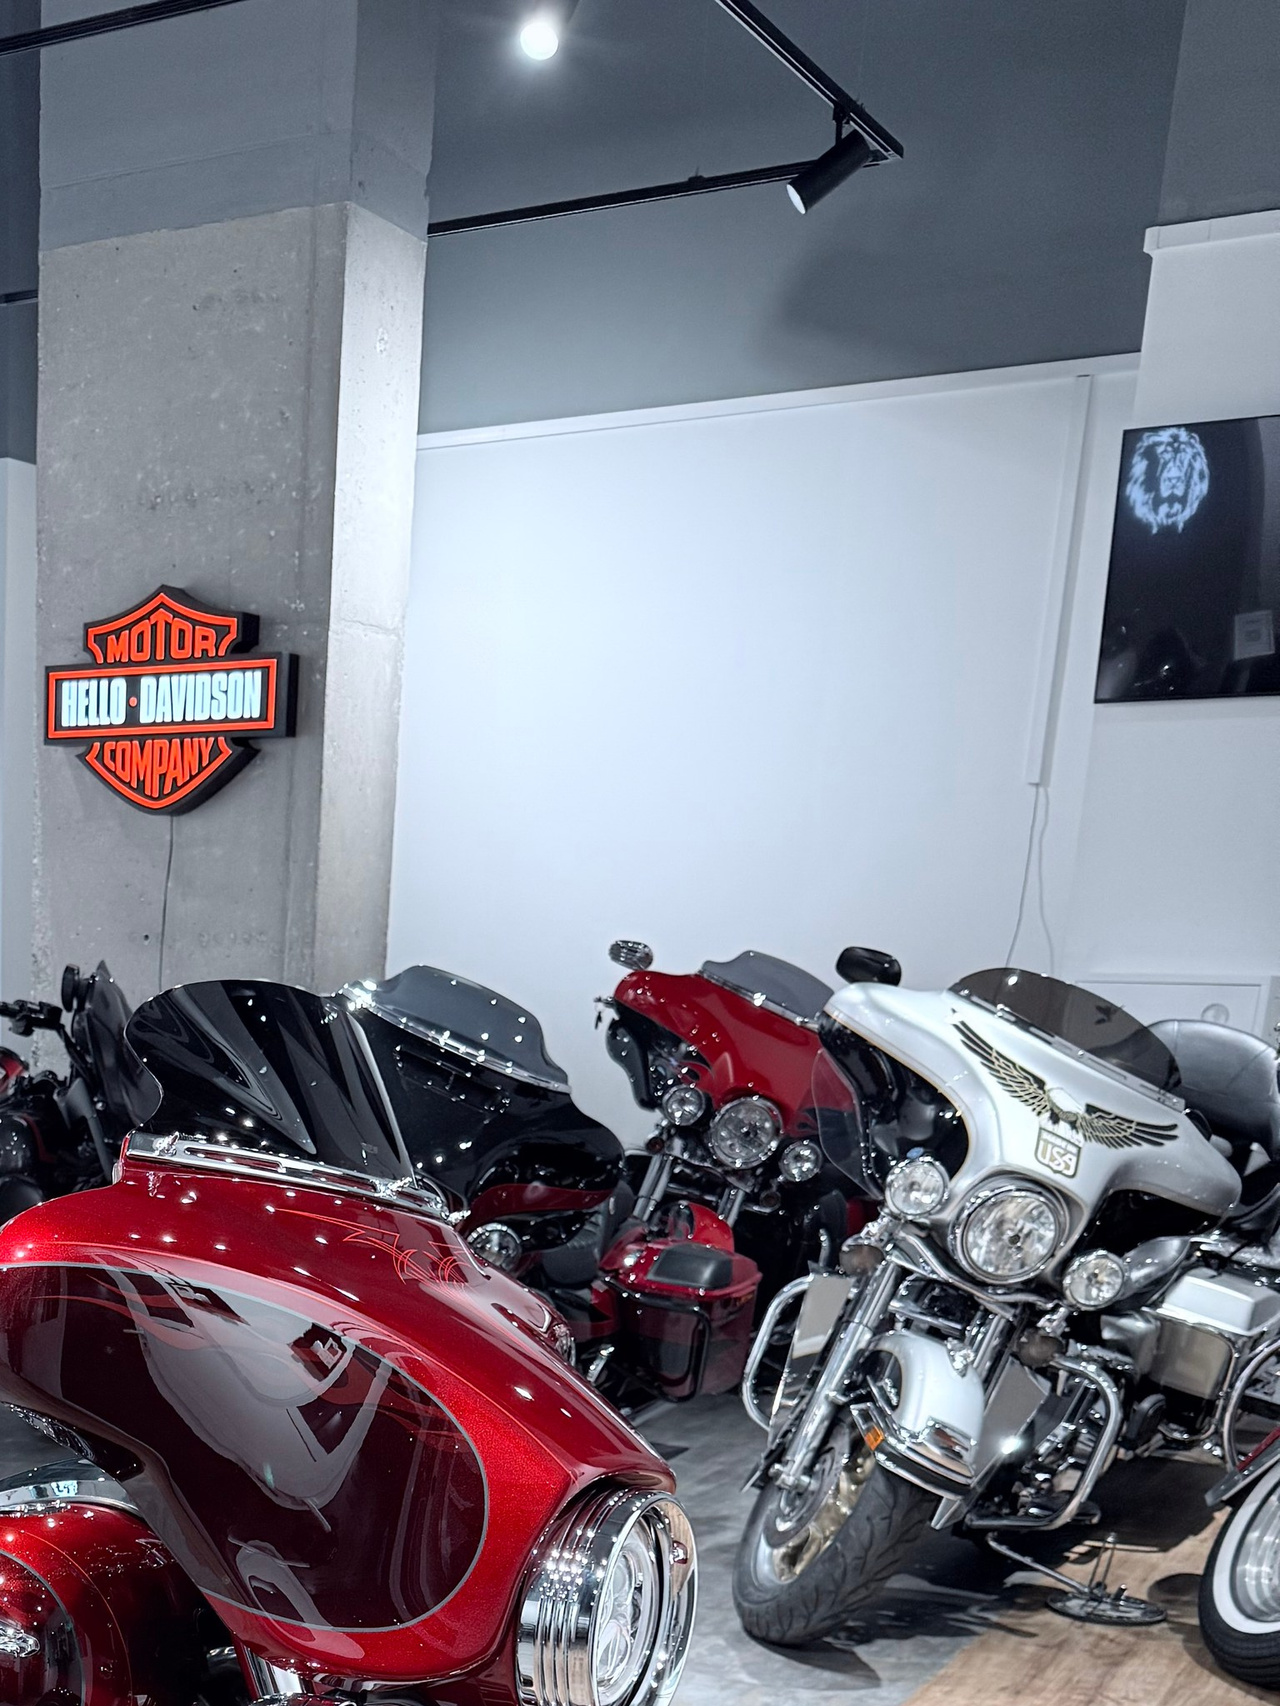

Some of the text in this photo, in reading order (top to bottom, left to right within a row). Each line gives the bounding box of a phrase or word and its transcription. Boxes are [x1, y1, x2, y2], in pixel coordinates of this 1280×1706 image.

[106, 608, 216, 663] MOTOR
[61, 670, 262, 727] HELLO DAVIDSON
[103, 737, 215, 798] COMPANY
